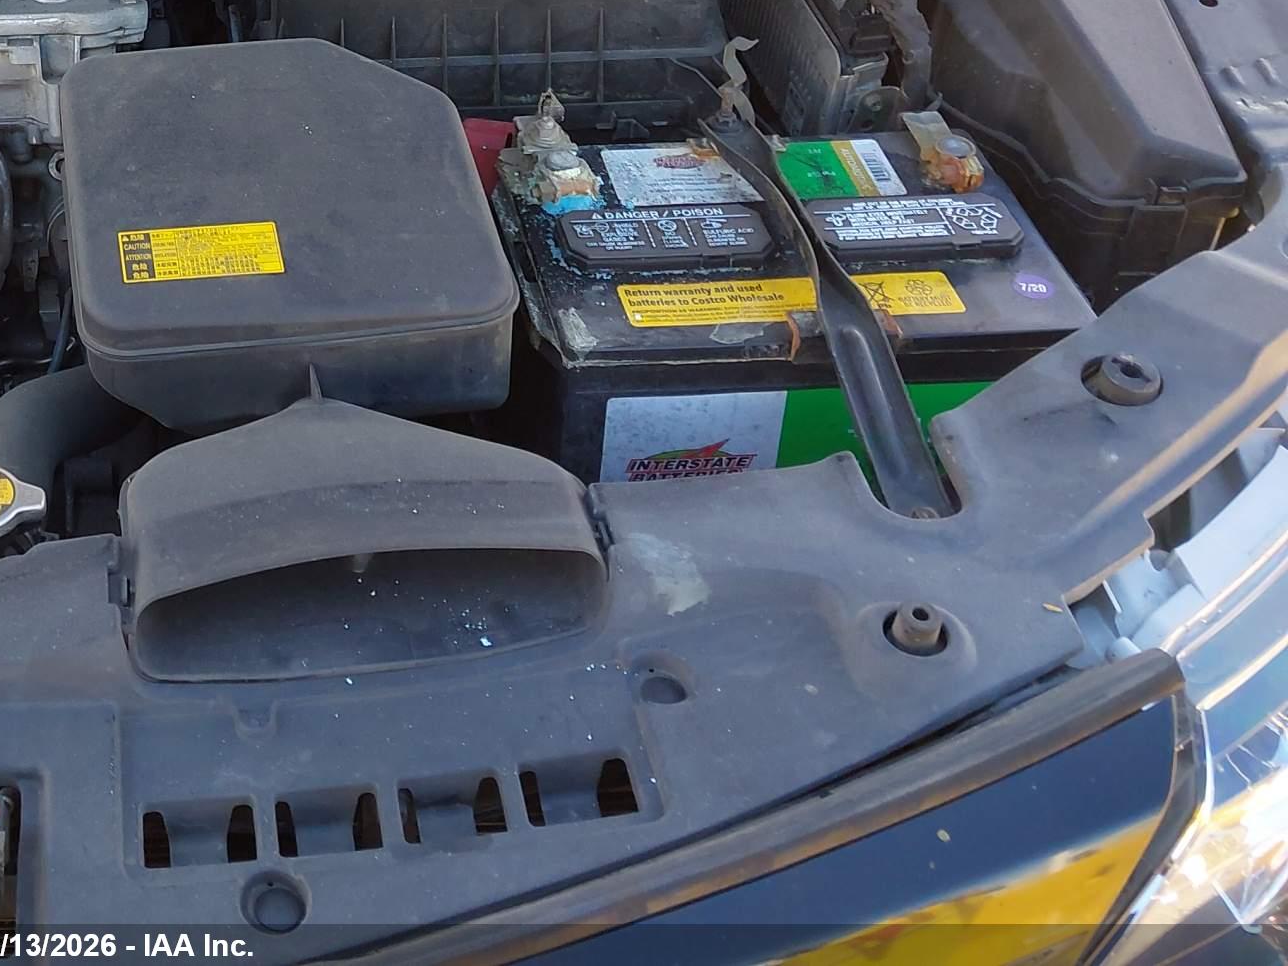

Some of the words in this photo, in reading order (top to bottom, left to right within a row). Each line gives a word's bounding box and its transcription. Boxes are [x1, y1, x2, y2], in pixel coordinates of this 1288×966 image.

[605, 210, 659, 219] DANGER
[672, 207, 724, 217] POISON
[123, 242, 150, 251] CAUTION
[125, 253, 151, 261] ATTENTION
[625, 289, 661, 297] Return
[663, 287, 712, 297] warranty
[714, 285, 734, 293] and
[737, 284, 762, 292] used
[628, 296, 676, 307] batteries
[679, 296, 689, 305] to
[691, 295, 725, 304] Costco
[727, 293, 785, 303] Wholesale
[631, 456, 748, 470] INTERSTATE
